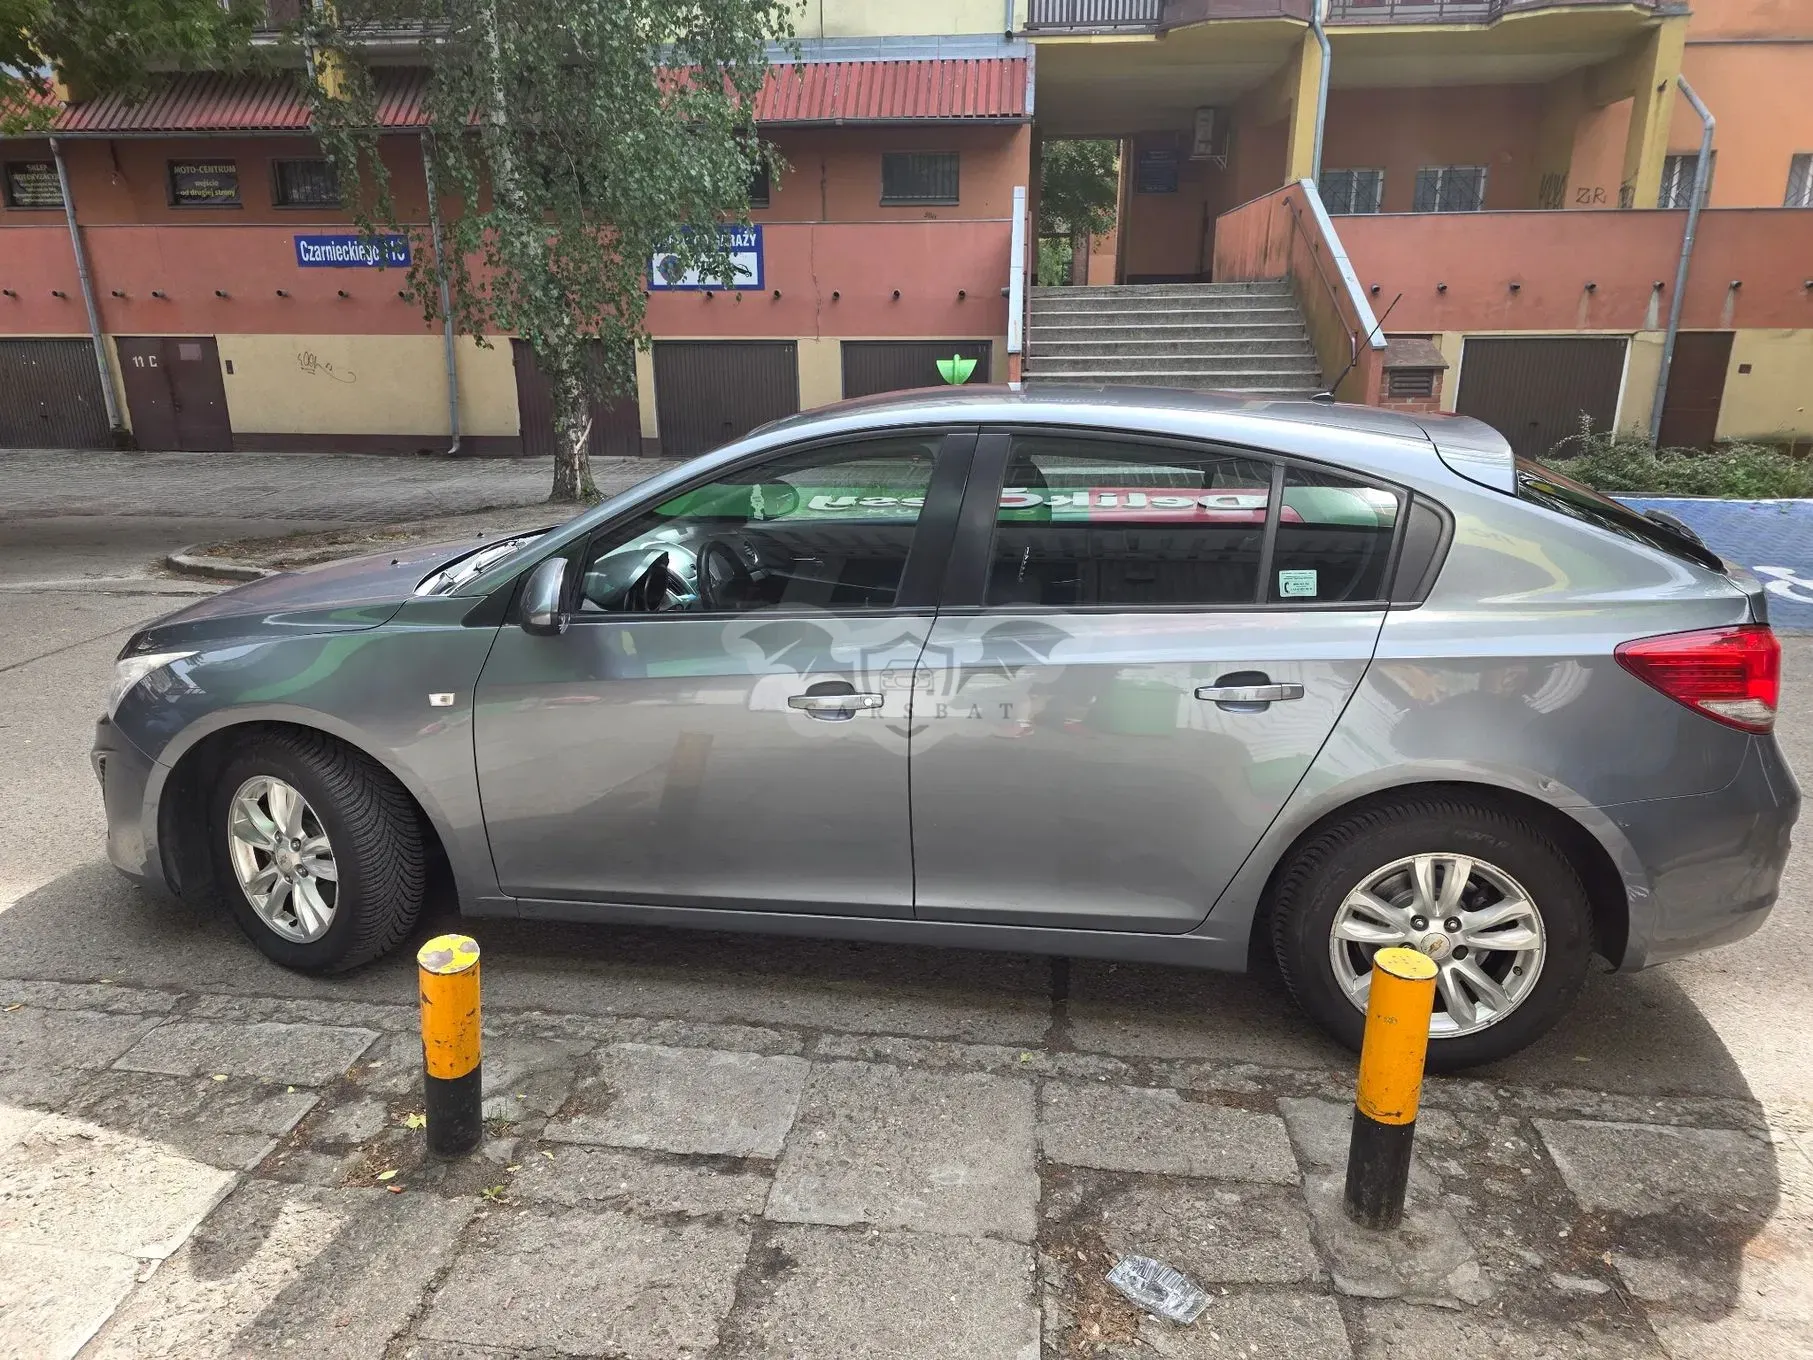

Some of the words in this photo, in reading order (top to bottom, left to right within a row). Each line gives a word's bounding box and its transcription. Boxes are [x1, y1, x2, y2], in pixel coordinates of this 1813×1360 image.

[173, 164, 237, 174] MOTO-CENTRUM
[190, 187, 214, 198] drugiej
[215, 189, 236, 198] strony
[132, 355, 145, 368] 11
